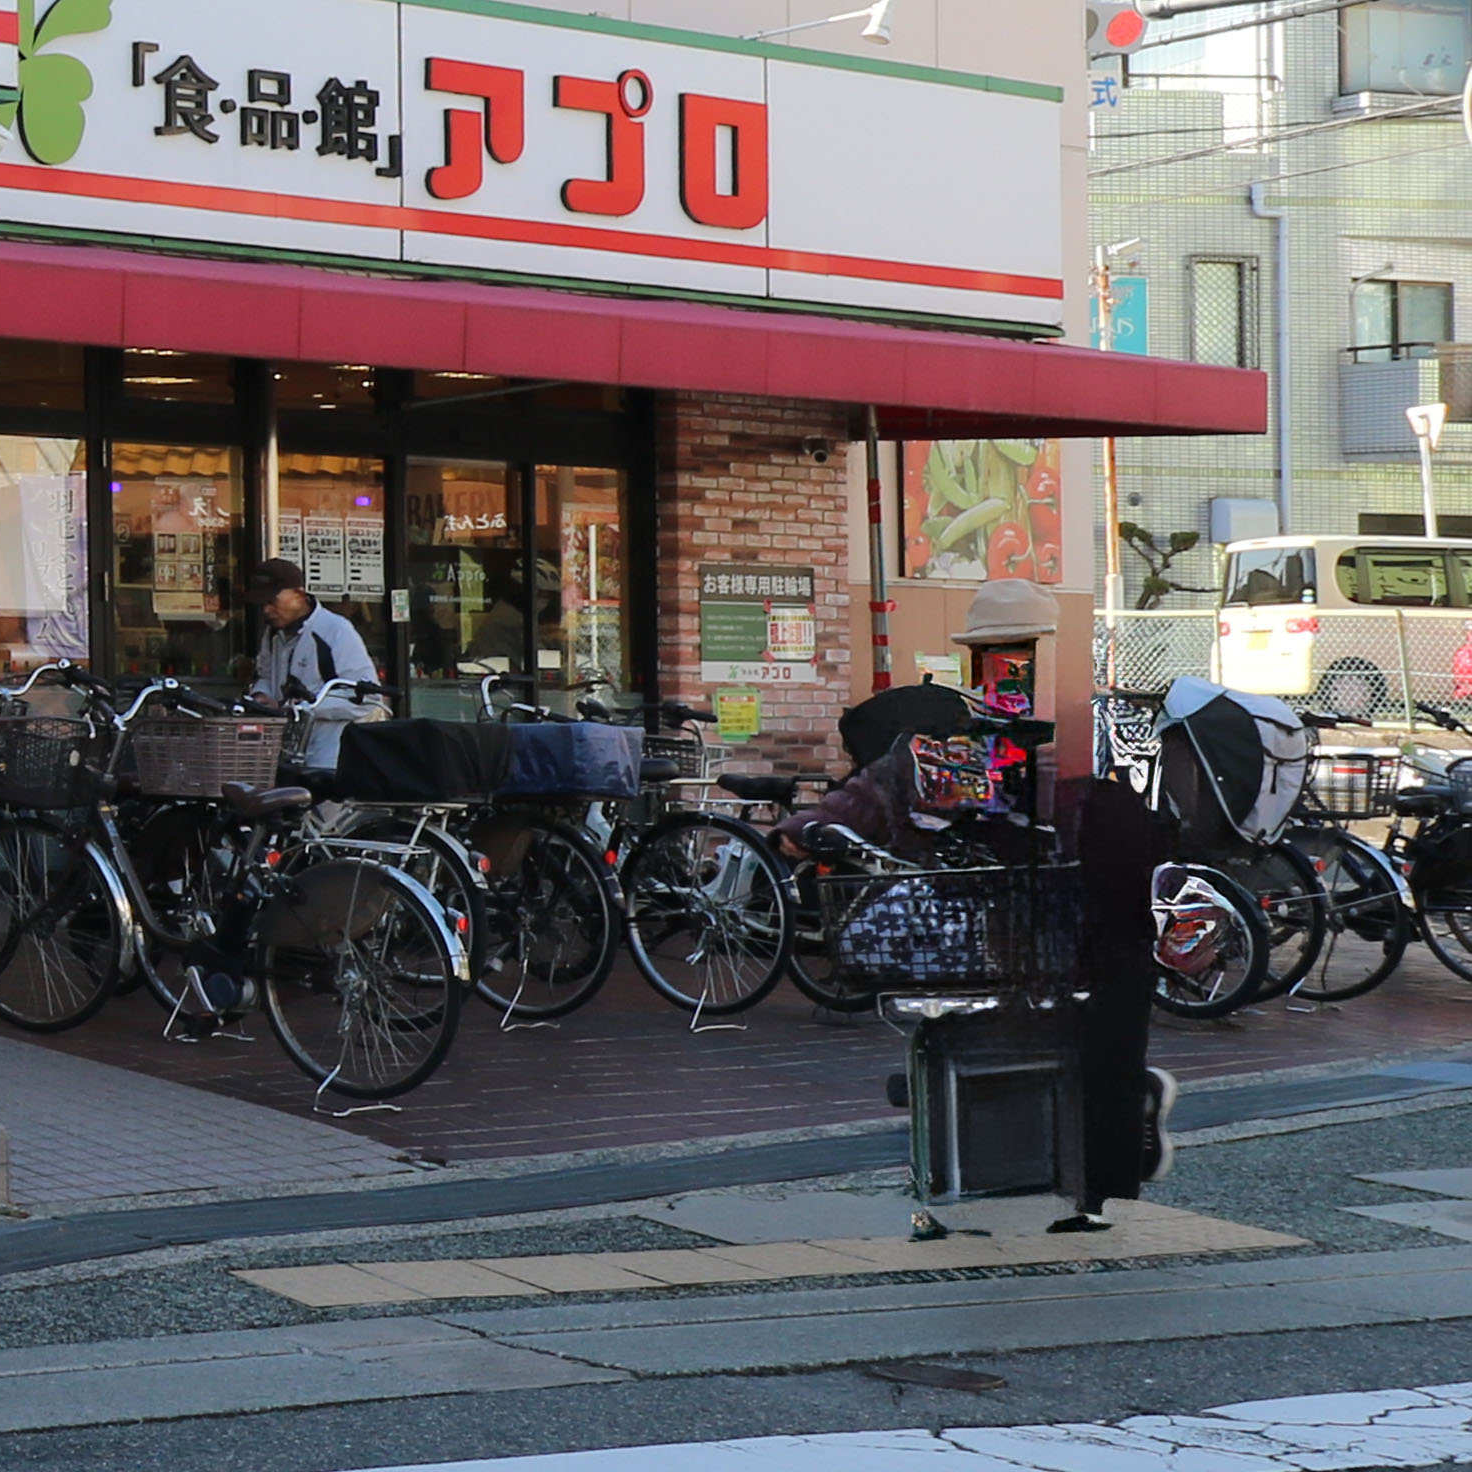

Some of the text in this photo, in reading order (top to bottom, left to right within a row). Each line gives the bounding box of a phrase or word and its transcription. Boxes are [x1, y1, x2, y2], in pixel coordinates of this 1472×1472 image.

[426, 56, 768, 230] アプロ
[703, 573, 812, 597] お客様専用駐輪場
